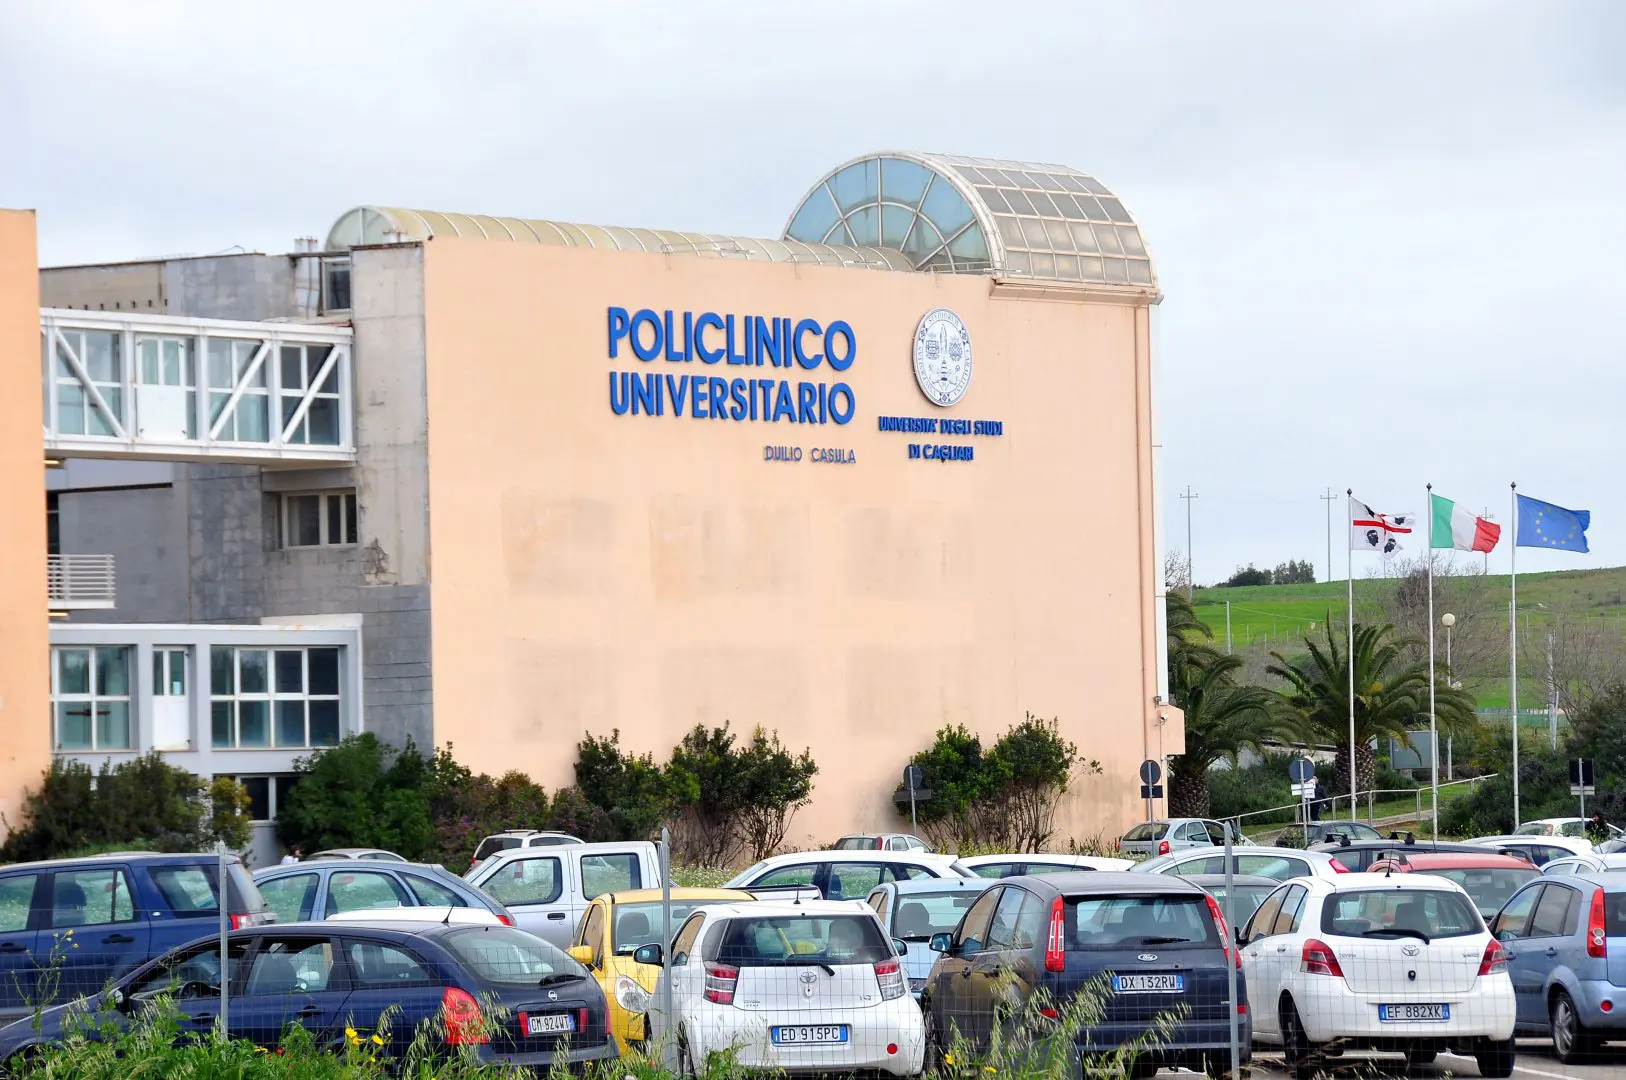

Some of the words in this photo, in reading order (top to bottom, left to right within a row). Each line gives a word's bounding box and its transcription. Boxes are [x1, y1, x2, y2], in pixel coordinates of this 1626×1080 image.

[608, 306, 856, 371] POLICLINICO
[609, 371, 856, 424] UNIVERSITARIO
[879, 416, 937, 432] UNIVERSITA'
[940, 419, 971, 435] DEGLI
[974, 421, 1003, 436] STUDI
[764, 445, 803, 462] DUILIO
[811, 447, 856, 463] CASULA
[908, 444, 920, 459] DI
[923, 444, 974, 460] CAGLIARI
[1121, 976, 1135, 989] DX
[1140, 976, 1176, 989] 132RW
[1388, 1005, 1401, 1018] EF
[1405, 1005, 1441, 1017] 882XK
[544, 1016, 569, 1030] 924WT
[781, 1028, 796, 1041] ED
[801, 1027, 839, 1040] 915PC
